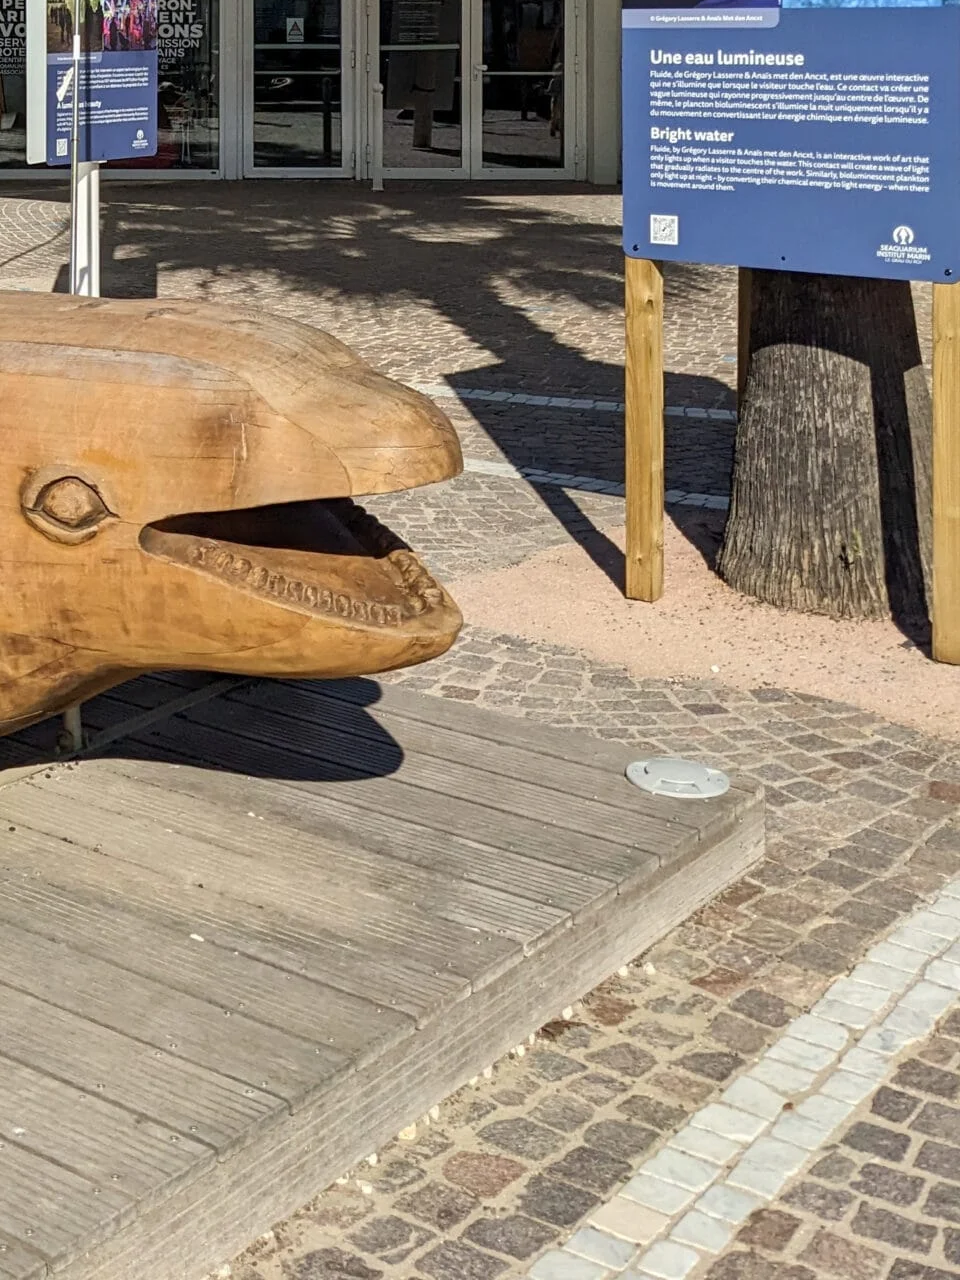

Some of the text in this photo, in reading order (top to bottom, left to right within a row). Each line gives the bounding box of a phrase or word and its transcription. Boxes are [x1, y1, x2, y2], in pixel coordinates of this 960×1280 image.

[159, 24, 203, 38] ONS
[650, 50, 804, 66] Une eau lumineuse
[650, 126, 734, 143] Bright water
[880, 244, 927, 253] SEAQUARIUM
